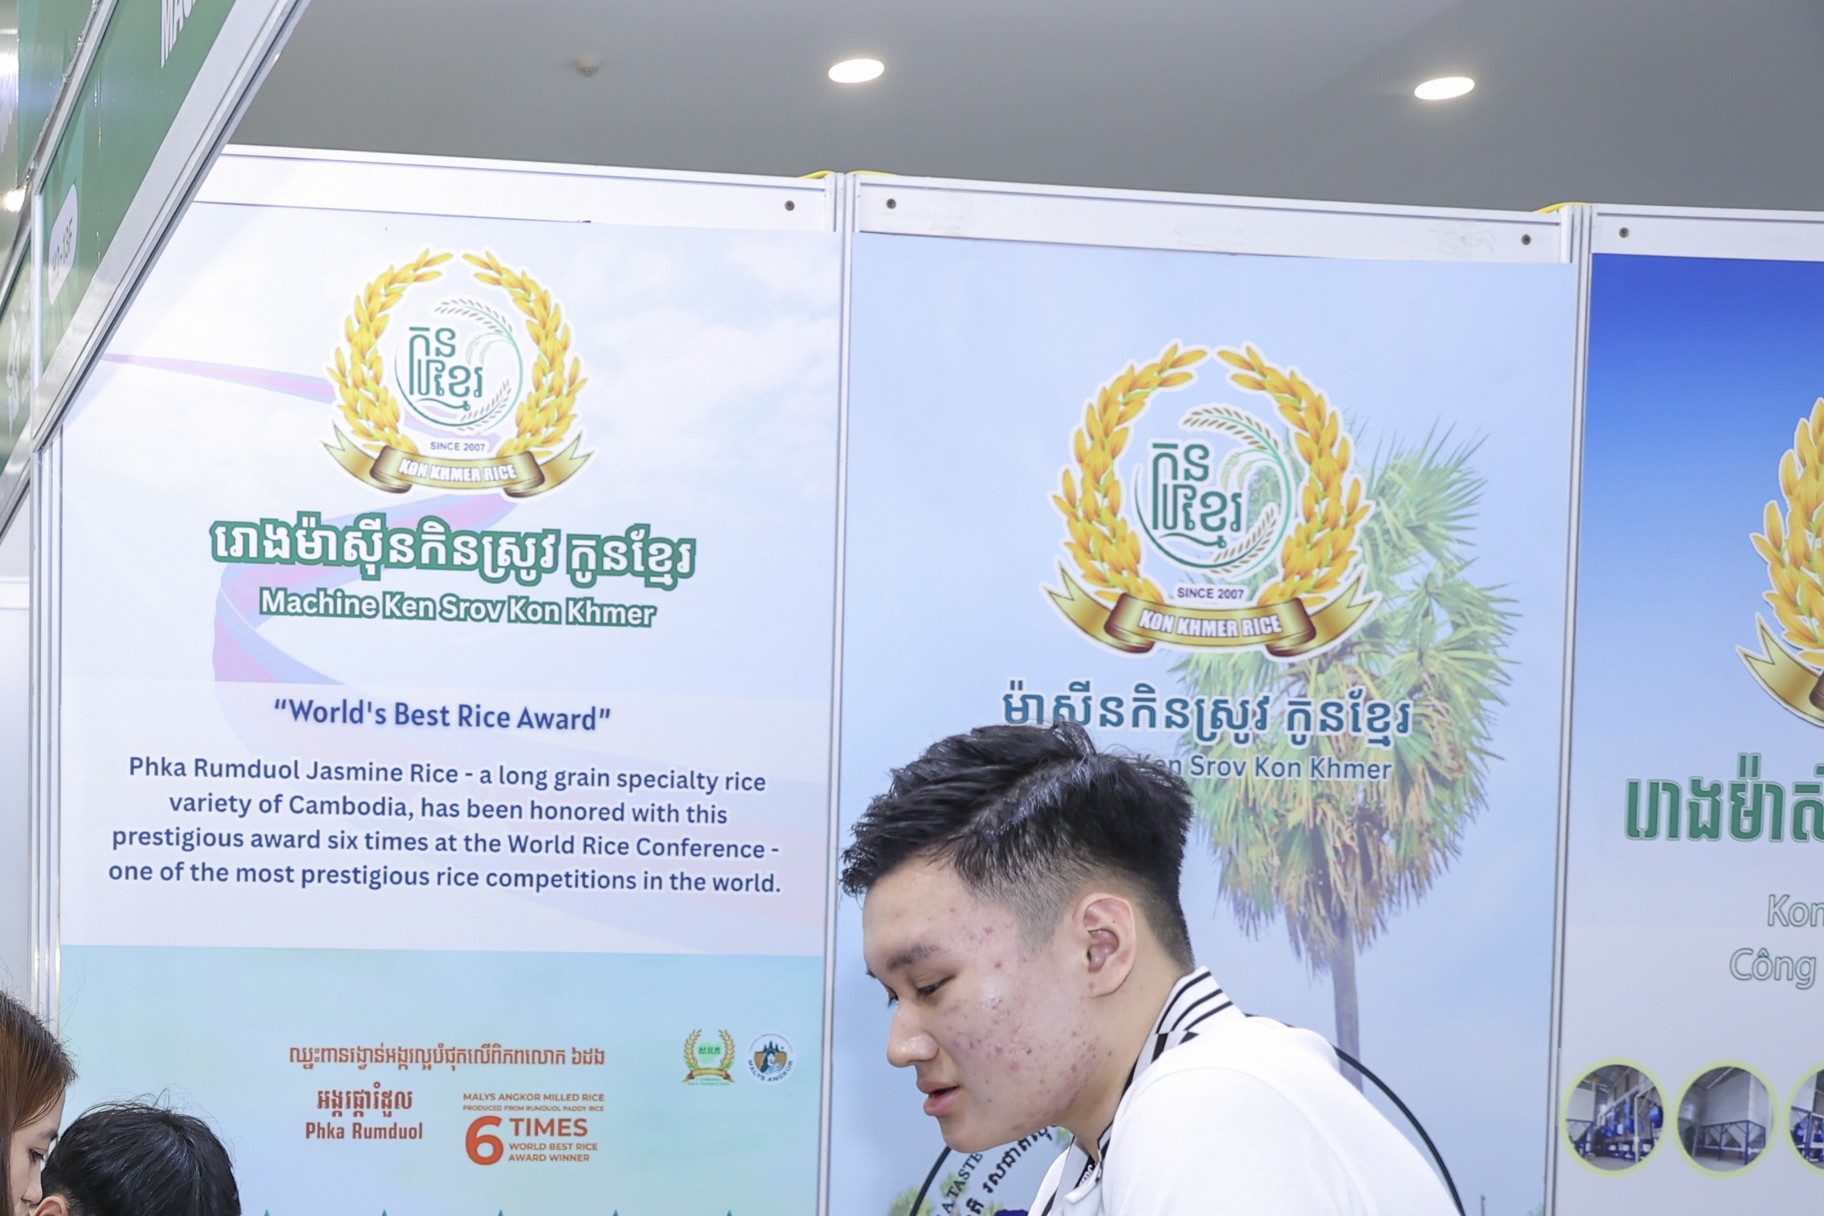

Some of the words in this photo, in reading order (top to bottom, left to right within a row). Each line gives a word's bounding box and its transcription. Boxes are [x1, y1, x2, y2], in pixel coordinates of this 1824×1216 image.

[430, 440, 460, 452] SINCE
[463, 441, 486, 453] 2007
[399, 457, 430, 480] KON
[432, 463, 482, 483] KHMER
[484, 461, 517, 482] RICE
[261, 589, 378, 617] Machine
[383, 592, 436, 618] Ken
[439, 595, 502, 621] Srov
[508, 598, 561, 622] Kon
[566, 599, 655, 626] Khmer
[1177, 587, 1214, 600] SINCE
[1217, 588, 1245, 601] 2007
[1138, 609, 1175, 633] KON
[1177, 616, 1240, 637] KHMER
[1242, 612, 1283, 636] RICE
[275, 699, 386, 725] “World's
[395, 702, 450, 727] Best
[458, 704, 510, 728] Rice
[517, 706, 610, 731] Award”
[130, 756, 187, 777] Phka
[195, 758, 300, 779] Rumduol
[306, 761, 403, 782] Jasmine
[411, 763, 458, 783] Rice
[480, 770, 492, 784] a
[500, 765, 548, 791] long
[554, 768, 609, 791] grain
[617, 770, 718, 795] specialty
[726, 772, 766, 791] rice
[1191, 753, 1246, 776] Srov
[1255, 756, 1301, 777] Kon
[1311, 756, 1392, 780] Khmer
[169, 792, 252, 818] variety
[259, 794, 283, 813] of
[289, 795, 413, 821] Cambodia,
[421, 797, 460, 818] has
[467, 798, 522, 819] been
[531, 800, 624, 821] honored
[632, 803, 679, 823] with
[686, 804, 727, 824] this
[113, 826, 244, 852] prestigious
[251, 829, 320, 849] award
[328, 830, 358, 849] six
[364, 831, 428, 851] times
[435, 835, 457, 852] at
[463, 833, 501, 853] the
[508, 835, 574, 854] World
[583, 836, 629, 855] Rice
[636, 838, 765, 858] Conference
[109, 865, 153, 880] one
[160, 861, 184, 881] of
[190, 862, 229, 882] the
[237, 866, 294, 883] most
[302, 865, 429, 890] prestigious
[437, 867, 479, 886] rice
[486, 869, 636, 893] competitions
[644, 871, 662, 890] in
[669, 871, 706, 891] the
[713, 873, 780, 892] world.
[1729, 947, 1817, 990] Công
[463, 1093, 496, 1101] MALYS
[498, 1093, 541, 1101] ANGKOR
[543, 1093, 580, 1101] MILLED
[582, 1094, 604, 1102] RICE
[306, 1122, 344, 1139] Phka
[352, 1122, 422, 1139] Rumduol
[465, 1115, 504, 1166] 6
[509, 1118, 588, 1137] TIMES
[508, 1154, 547, 1162] AWARD
[549, 1154, 590, 1162] WINNER
[509, 1143, 547, 1151] WORLD
[549, 1143, 573, 1151] BEST
[576, 1143, 597, 1151] RICE
[947, 1152, 984, 1203] TASTE
[941, 1200, 955, 1216] A
